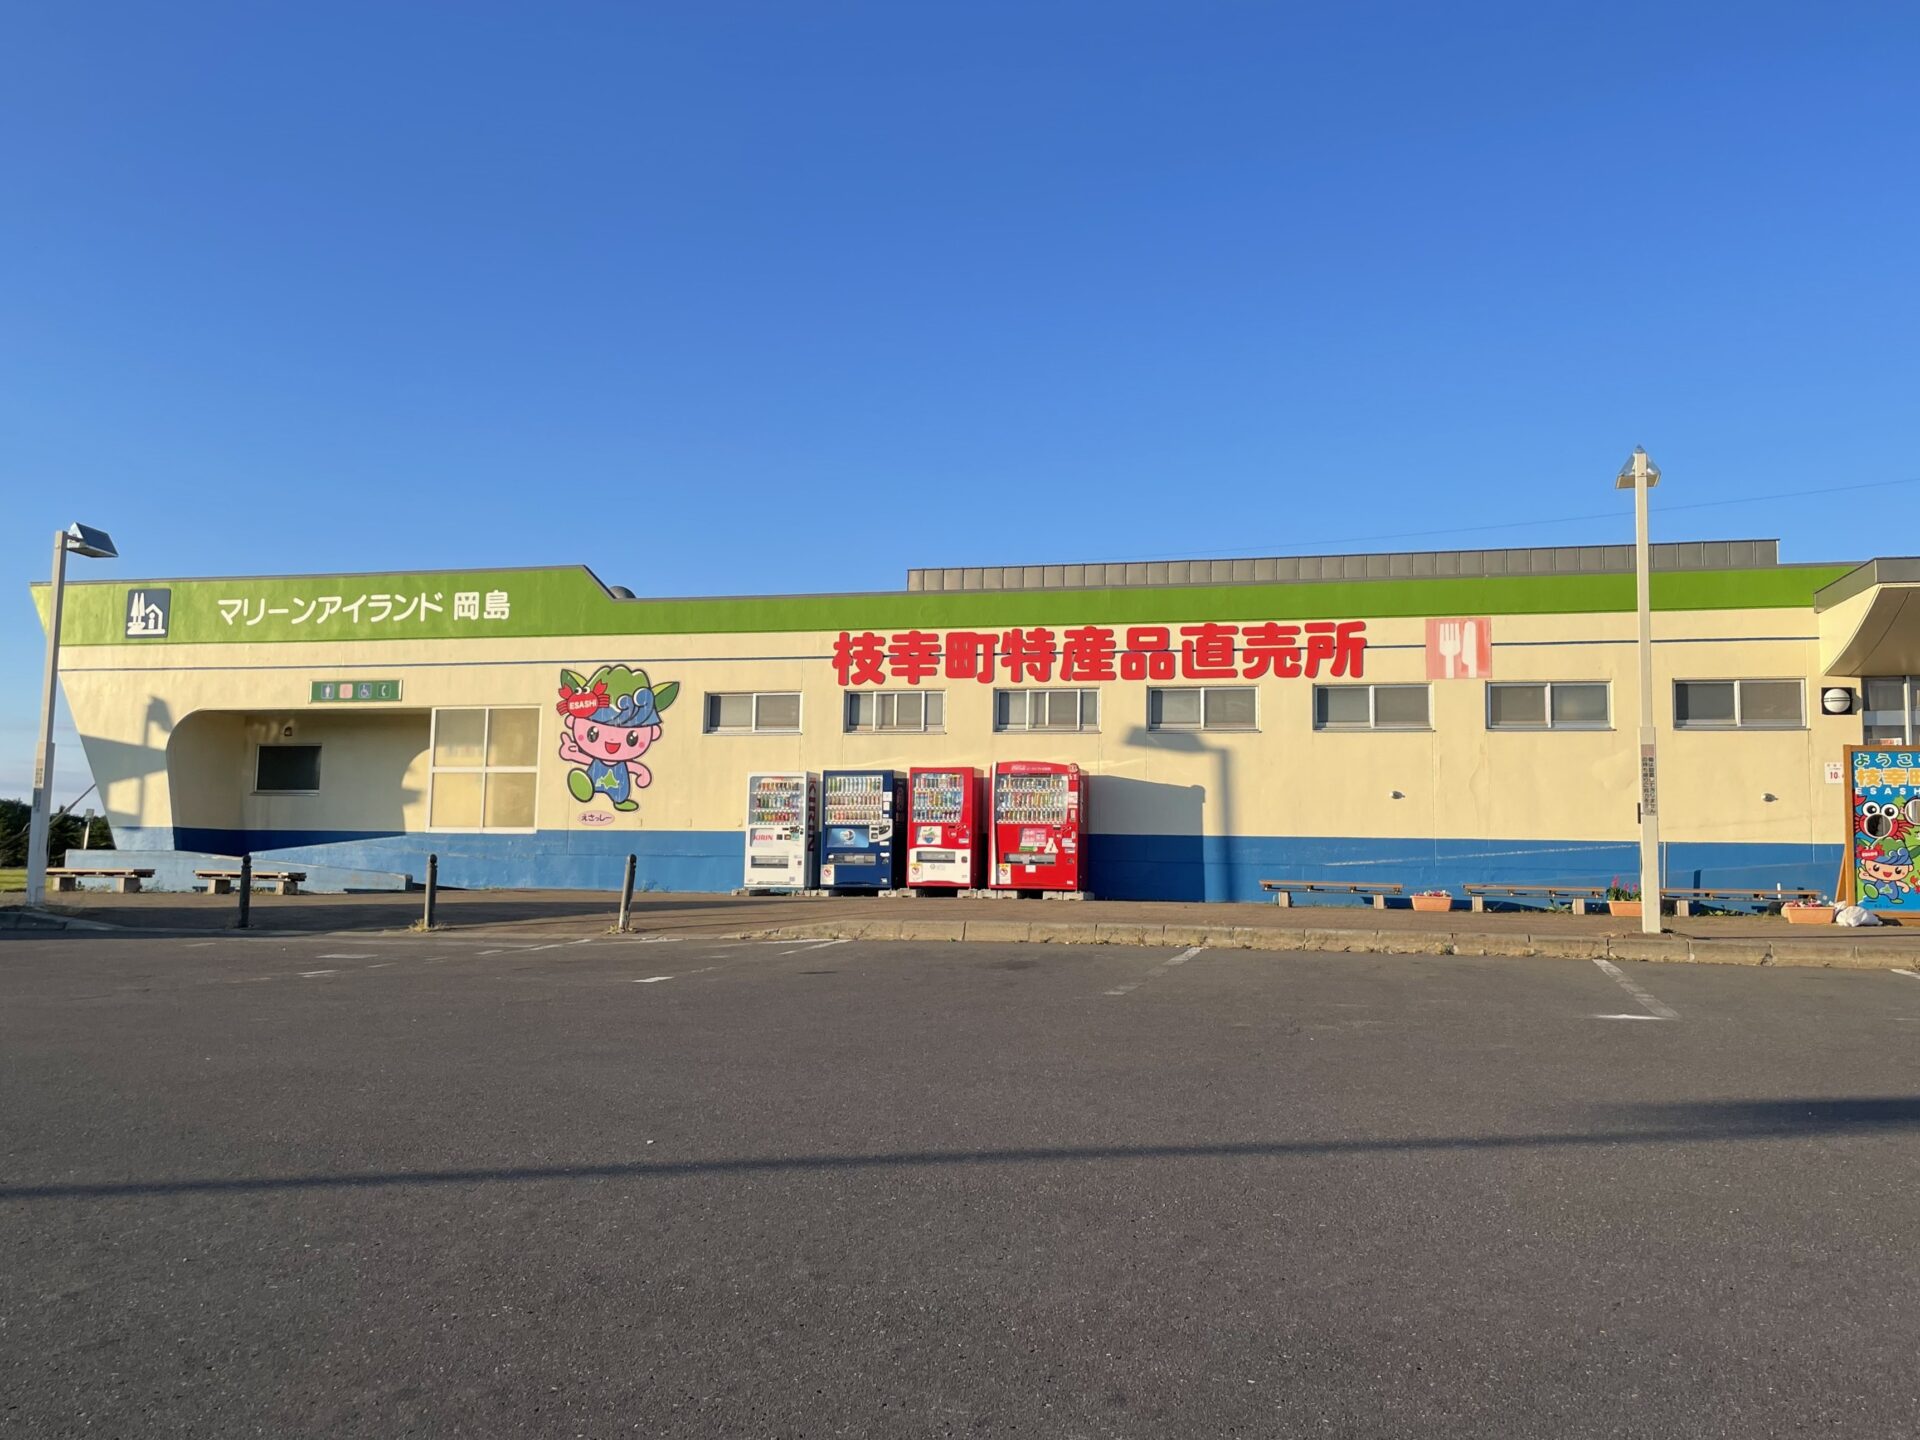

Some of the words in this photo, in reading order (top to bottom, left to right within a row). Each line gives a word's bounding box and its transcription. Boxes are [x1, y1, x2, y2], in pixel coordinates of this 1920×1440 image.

[217, 591, 444, 625] マリーンアイランド
[453, 590, 511, 621] 岡島
[832, 621, 1367, 686] 枝幸町特産品直売所
[569, 699, 597, 710] ESASHI
[1854, 753, 1920, 767] ようこ
